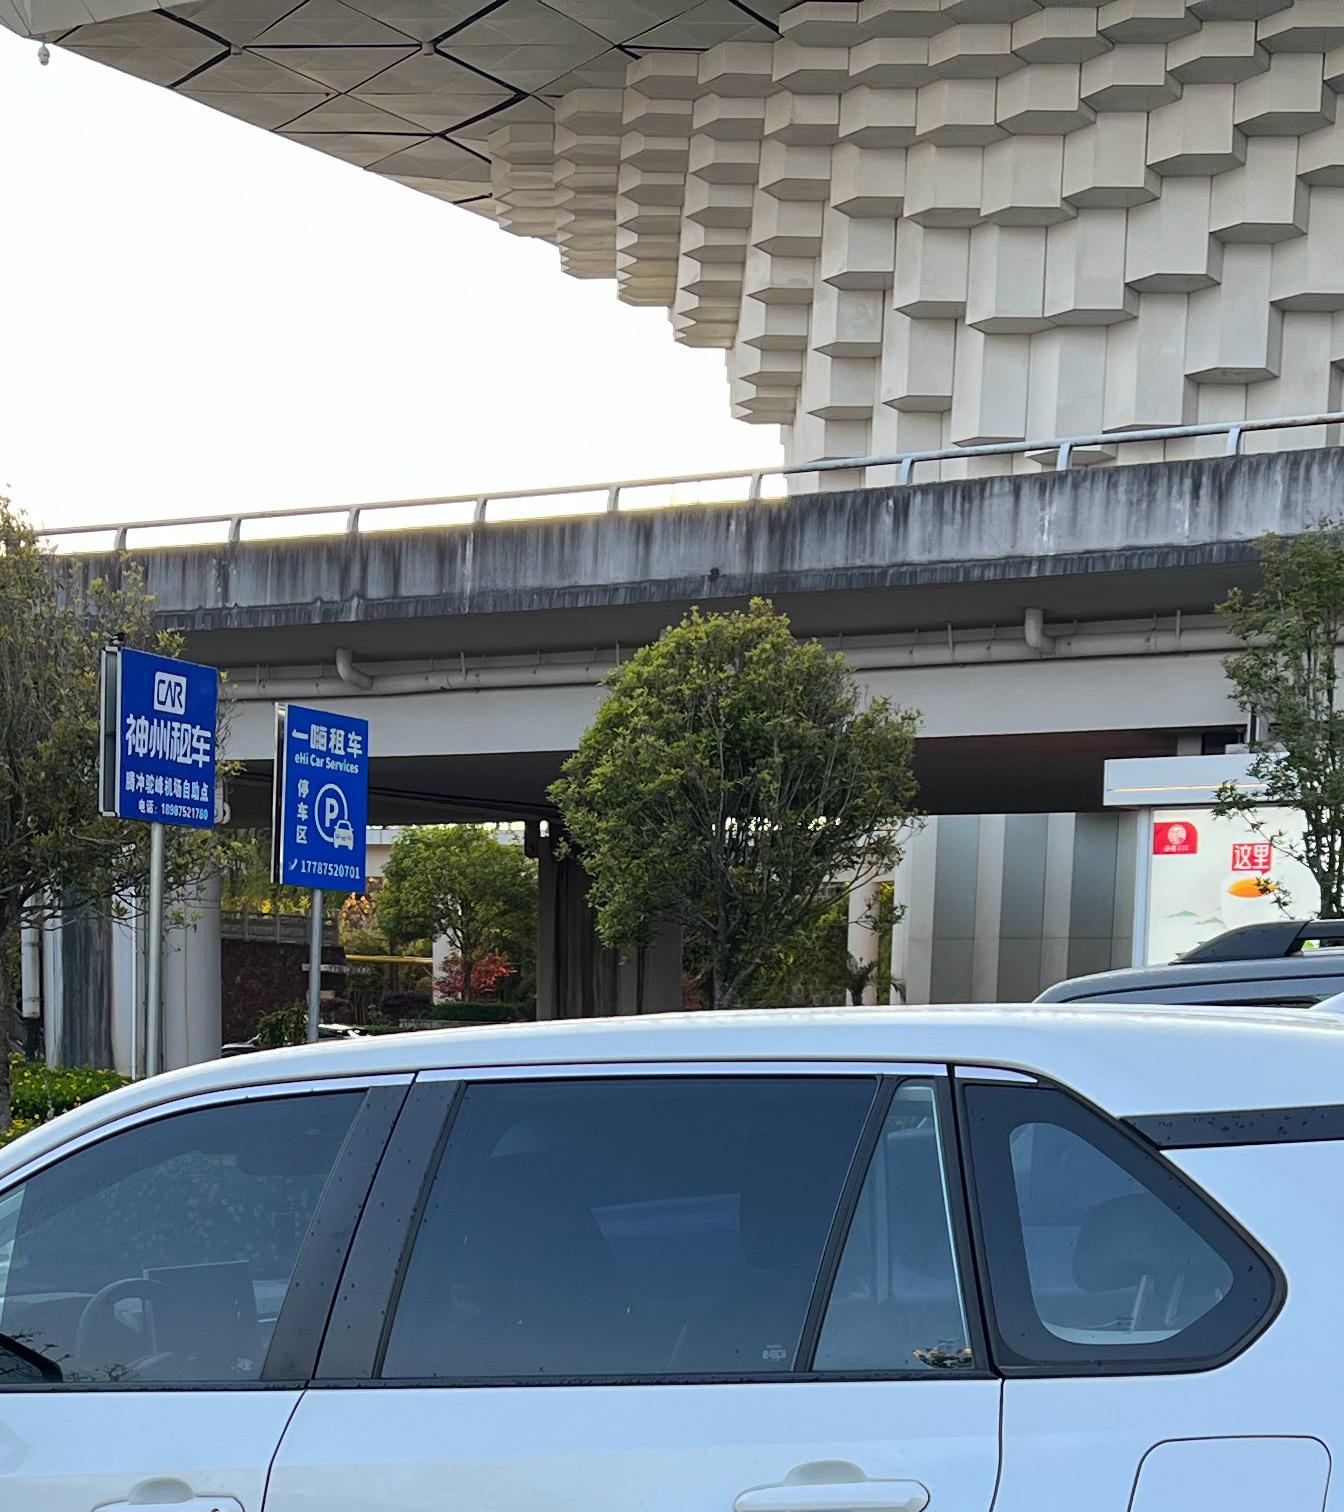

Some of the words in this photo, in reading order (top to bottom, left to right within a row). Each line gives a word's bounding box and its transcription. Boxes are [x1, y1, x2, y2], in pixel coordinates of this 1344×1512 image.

[156, 679, 184, 709] CAR
[125, 713, 212, 768] 神州租车
[292, 724, 363, 758] 一嗨租车
[294, 752, 309, 765] eHi
[310, 753, 325, 768] Car
[325, 756, 360, 774] Services
[296, 778, 310, 845] 停车区
[324, 797, 339, 827] P
[300, 859, 361, 880] 17787520701
[1234, 844, 1270, 870] 这里
